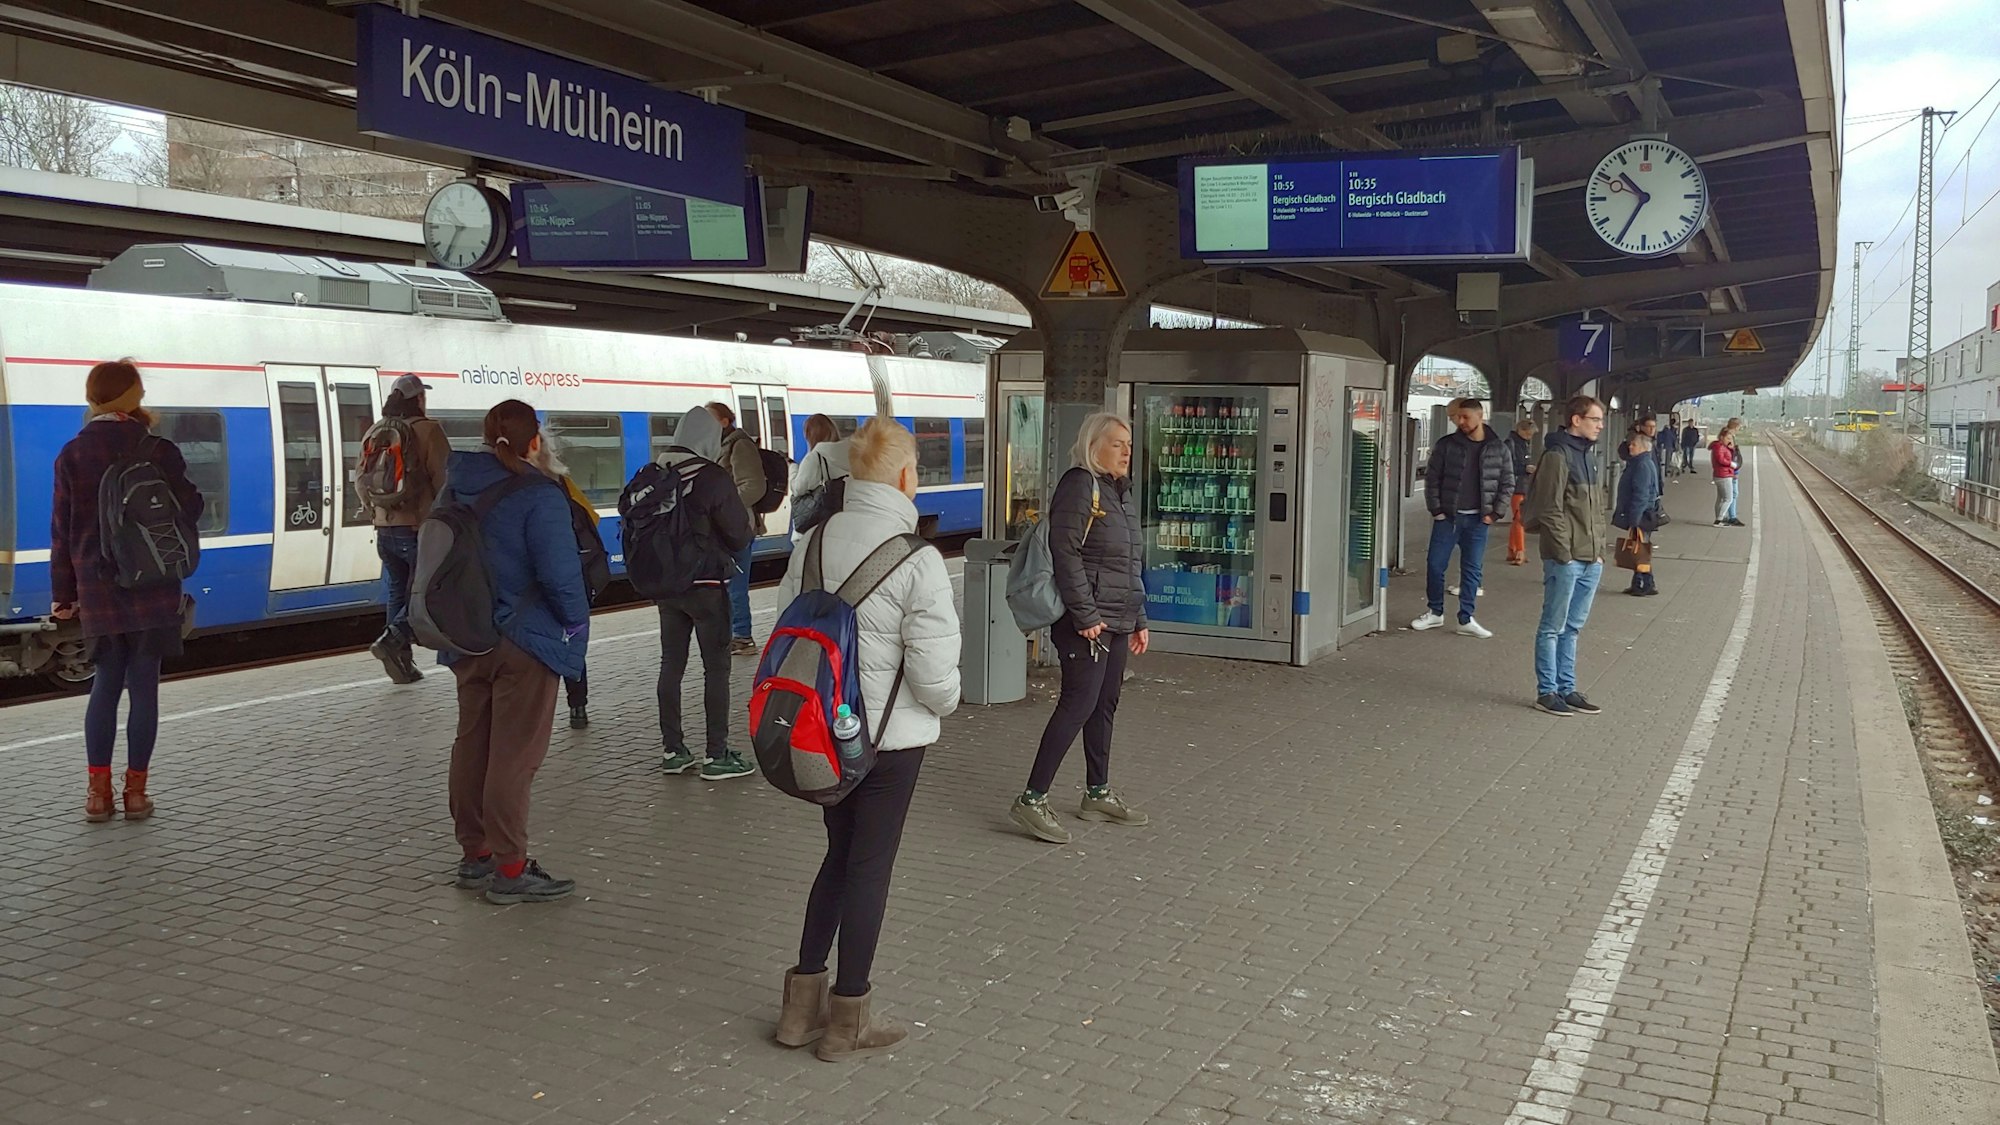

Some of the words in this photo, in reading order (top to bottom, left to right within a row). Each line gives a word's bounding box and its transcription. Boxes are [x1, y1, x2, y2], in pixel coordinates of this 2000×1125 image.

[402, 37, 683, 162] Köln-Mülheim
[1273, 181, 1295, 191] 10:55
[1348, 178, 1377, 190] 10:35
[1273, 194, 1302, 206] Bergisch
[1303, 194, 1336, 204] Gladbach
[1348, 191, 1393, 208] Bergisch
[1395, 190, 1446, 205] Gladbach
[530, 216, 575, 227] Köln-Nippes
[1580, 324, 1604, 363] 7
[462, 364, 523, 385] national
[524, 371, 581, 391] express
[1163, 585, 1176, 594] RED
